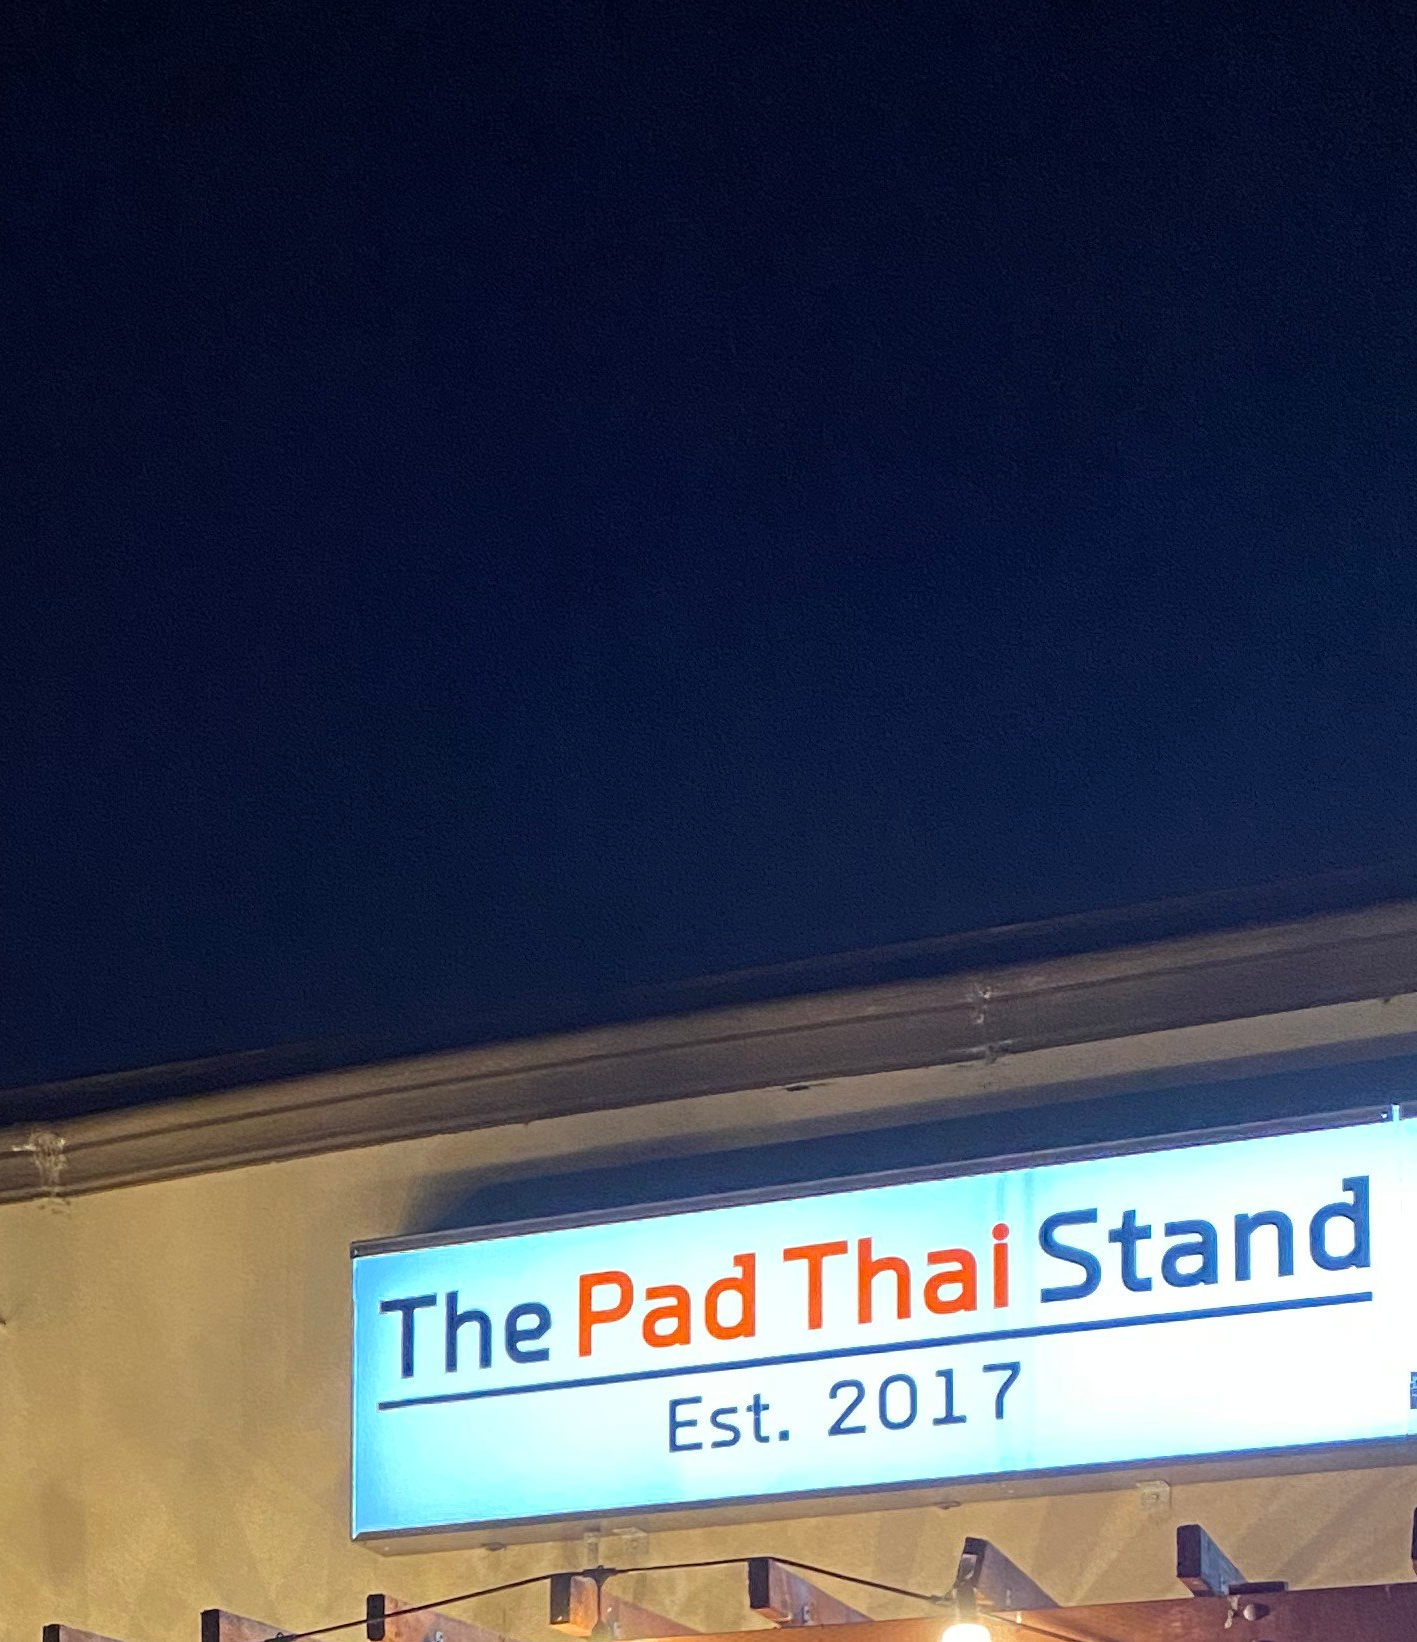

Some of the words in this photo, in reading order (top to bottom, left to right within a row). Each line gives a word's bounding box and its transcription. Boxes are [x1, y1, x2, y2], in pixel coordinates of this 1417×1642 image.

[380, 1291, 551, 1378] The
[578, 1253, 756, 1357] Pad
[783, 1223, 1009, 1330] Thai
[1038, 1176, 1372, 1303] Stand
[669, 1393, 790, 1452] Est.
[827, 1361, 1022, 1437] 2017
